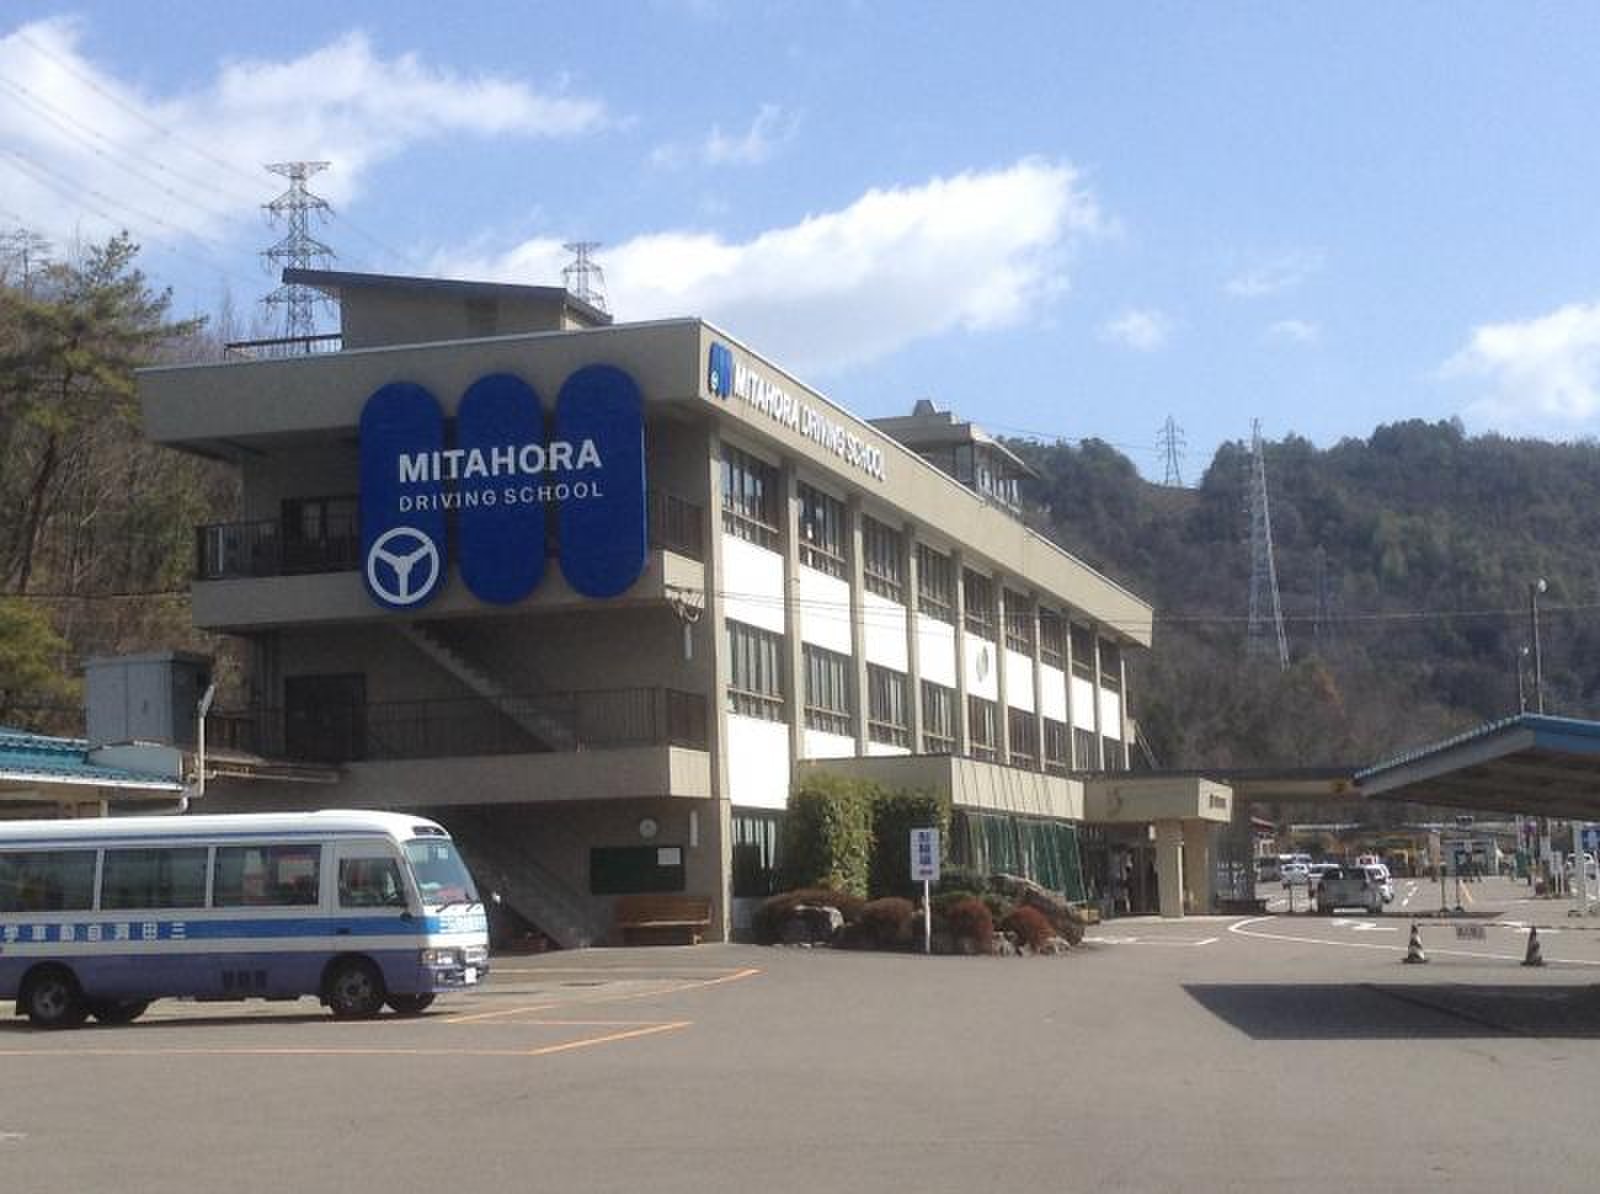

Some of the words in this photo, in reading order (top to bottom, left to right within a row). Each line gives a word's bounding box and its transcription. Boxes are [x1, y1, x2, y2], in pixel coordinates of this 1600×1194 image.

[735, 365, 799, 431] MITAHORA
[399, 439, 602, 483] MITAHORA
[399, 489, 497, 513] DRIVING
[504, 482, 604, 505] SCHOOL
